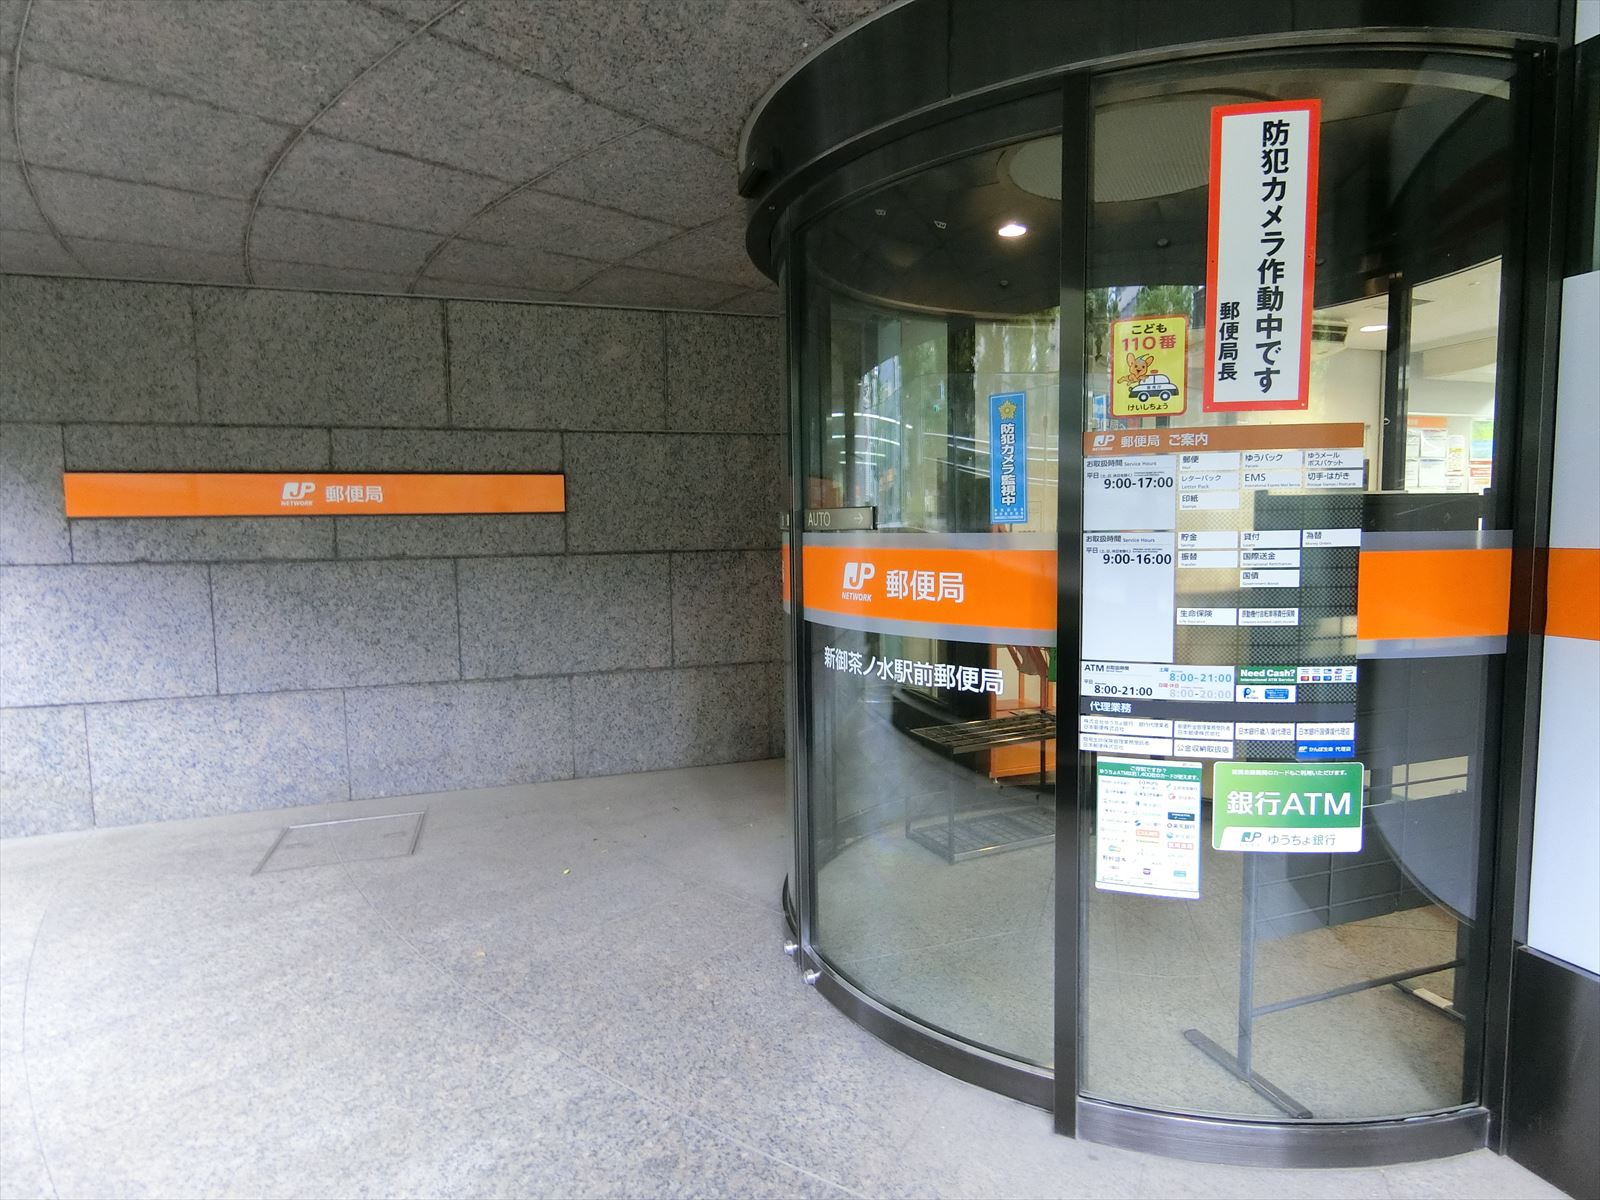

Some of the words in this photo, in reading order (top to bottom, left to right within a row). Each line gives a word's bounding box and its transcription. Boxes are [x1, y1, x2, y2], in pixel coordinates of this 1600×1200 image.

[1254, 119, 1290, 393] 防犯カメラ作動中です
[1132, 323, 1167, 334] こども
[1122, 335, 1176, 351] 110番
[1218, 301, 1240, 381] 郵便局長
[1128, 403, 1169, 411] けいしちょう
[1121, 435, 1160, 448] 郵便局
[1169, 432, 1209, 446] ご案内
[1000, 423, 1016, 506] 防犯カメラ監視中
[1087, 460, 1123, 468] お取扱時間
[1183, 455, 1199, 463] 郵便
[1104, 477, 1173, 489] 9:00-17:00
[1244, 473, 1266, 482] EMS
[326, 485, 384, 503] 郵便局
[808, 512, 831, 527] AUTO
[1086, 535, 1122, 543] お取扱時間
[1181, 533, 1197, 541] 貯金
[1103, 554, 1172, 564] 9:00-16:00
[1243, 552, 1276, 560] 国際送金
[886, 570, 964, 603] 郵便局
[842, 591, 872, 602] NETWORK
[1180, 610, 1213, 618] 生命保険
[824, 645, 1005, 695] 新御茶ノ水駅前郵便局
[1084, 664, 1105, 672] ATM
[1240, 669, 1265, 677] Need
[1266, 669, 1296, 677] Cash?
[1169, 673, 1232, 683] 8:00-21:00
[1094, 685, 1153, 696] 8:00-21:00
[1169, 688, 1232, 699] 8:00-20:00
[1090, 701, 1132, 713] 代理業務
[1227, 791, 1351, 816] 銀行ATM
[1268, 834, 1336, 846] ゆうちょ銀行
